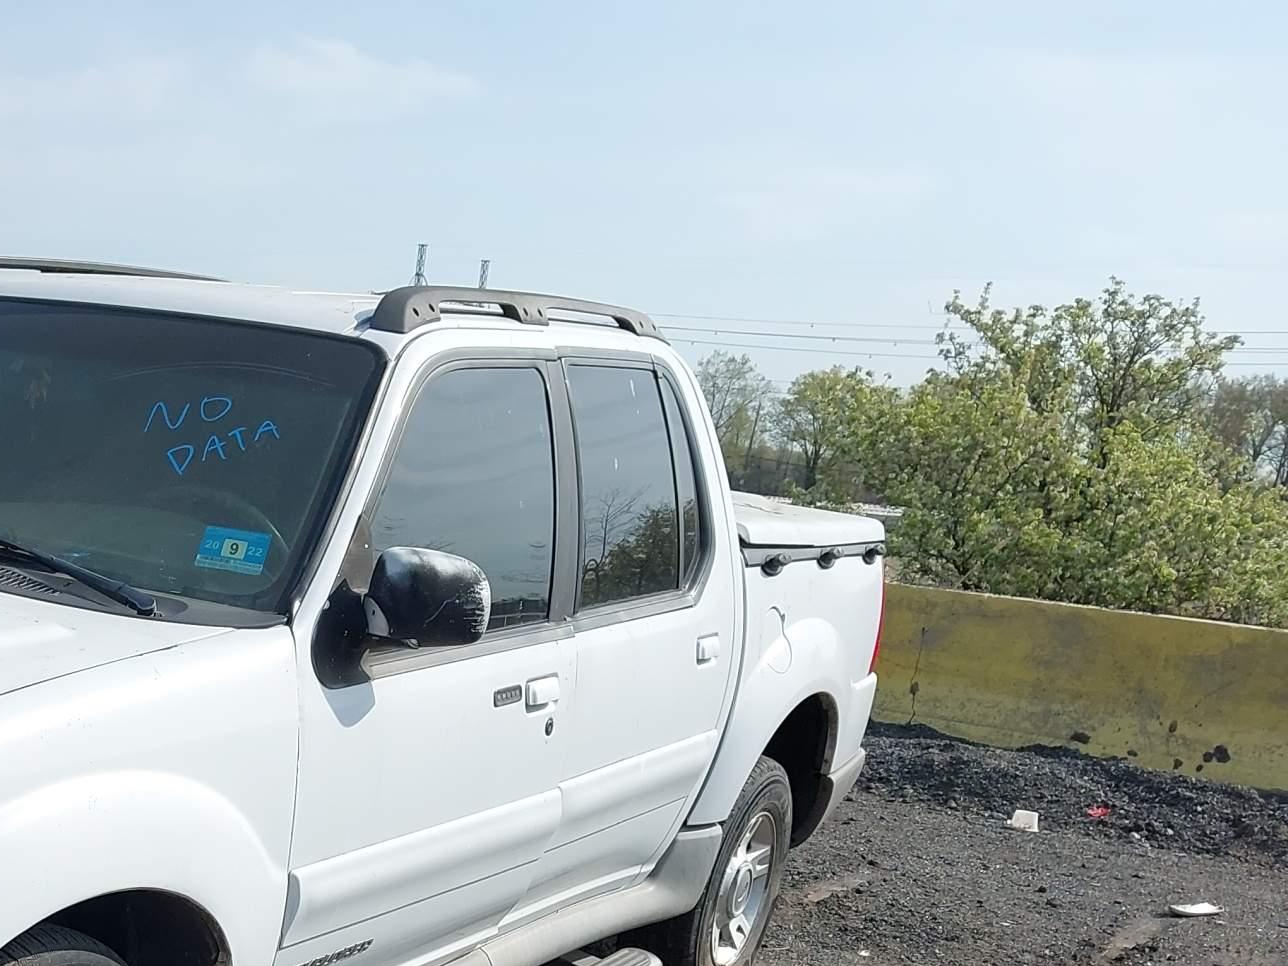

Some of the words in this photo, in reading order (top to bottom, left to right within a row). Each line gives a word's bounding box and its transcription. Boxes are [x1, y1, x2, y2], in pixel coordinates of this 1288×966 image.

[143, 396, 233, 433] NO
[166, 420, 280, 476] DATA
[204, 539, 221, 550] 20
[229, 542, 239, 556] 9
